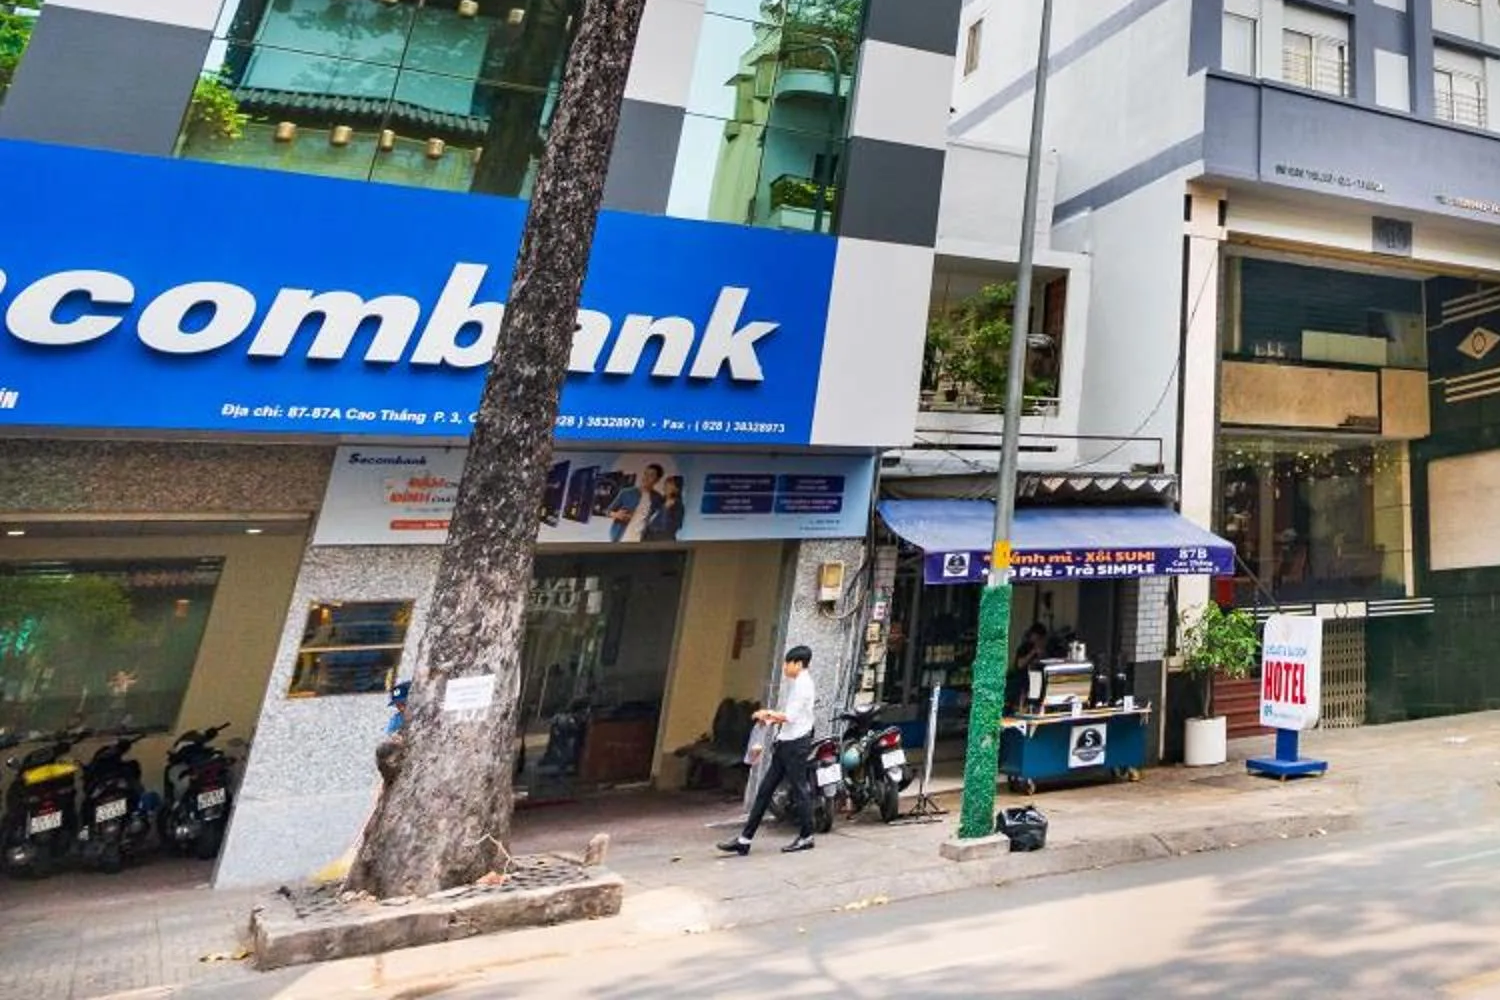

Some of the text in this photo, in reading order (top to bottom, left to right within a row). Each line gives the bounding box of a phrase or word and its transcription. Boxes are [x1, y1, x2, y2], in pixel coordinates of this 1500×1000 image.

[0, 262, 780, 382] combnk
[287, 406, 341, 420] 87-87A
[345, 407, 376, 421] Cao
[1009, 552, 1044, 564] ánh
[1179, 548, 1207, 559] 87B
[1020, 564, 1052, 577] Phê
[1065, 564, 1094, 575] Trà
[1097, 563, 1155, 575] SIMPLE
[1264, 660, 1306, 705] HOTEL
